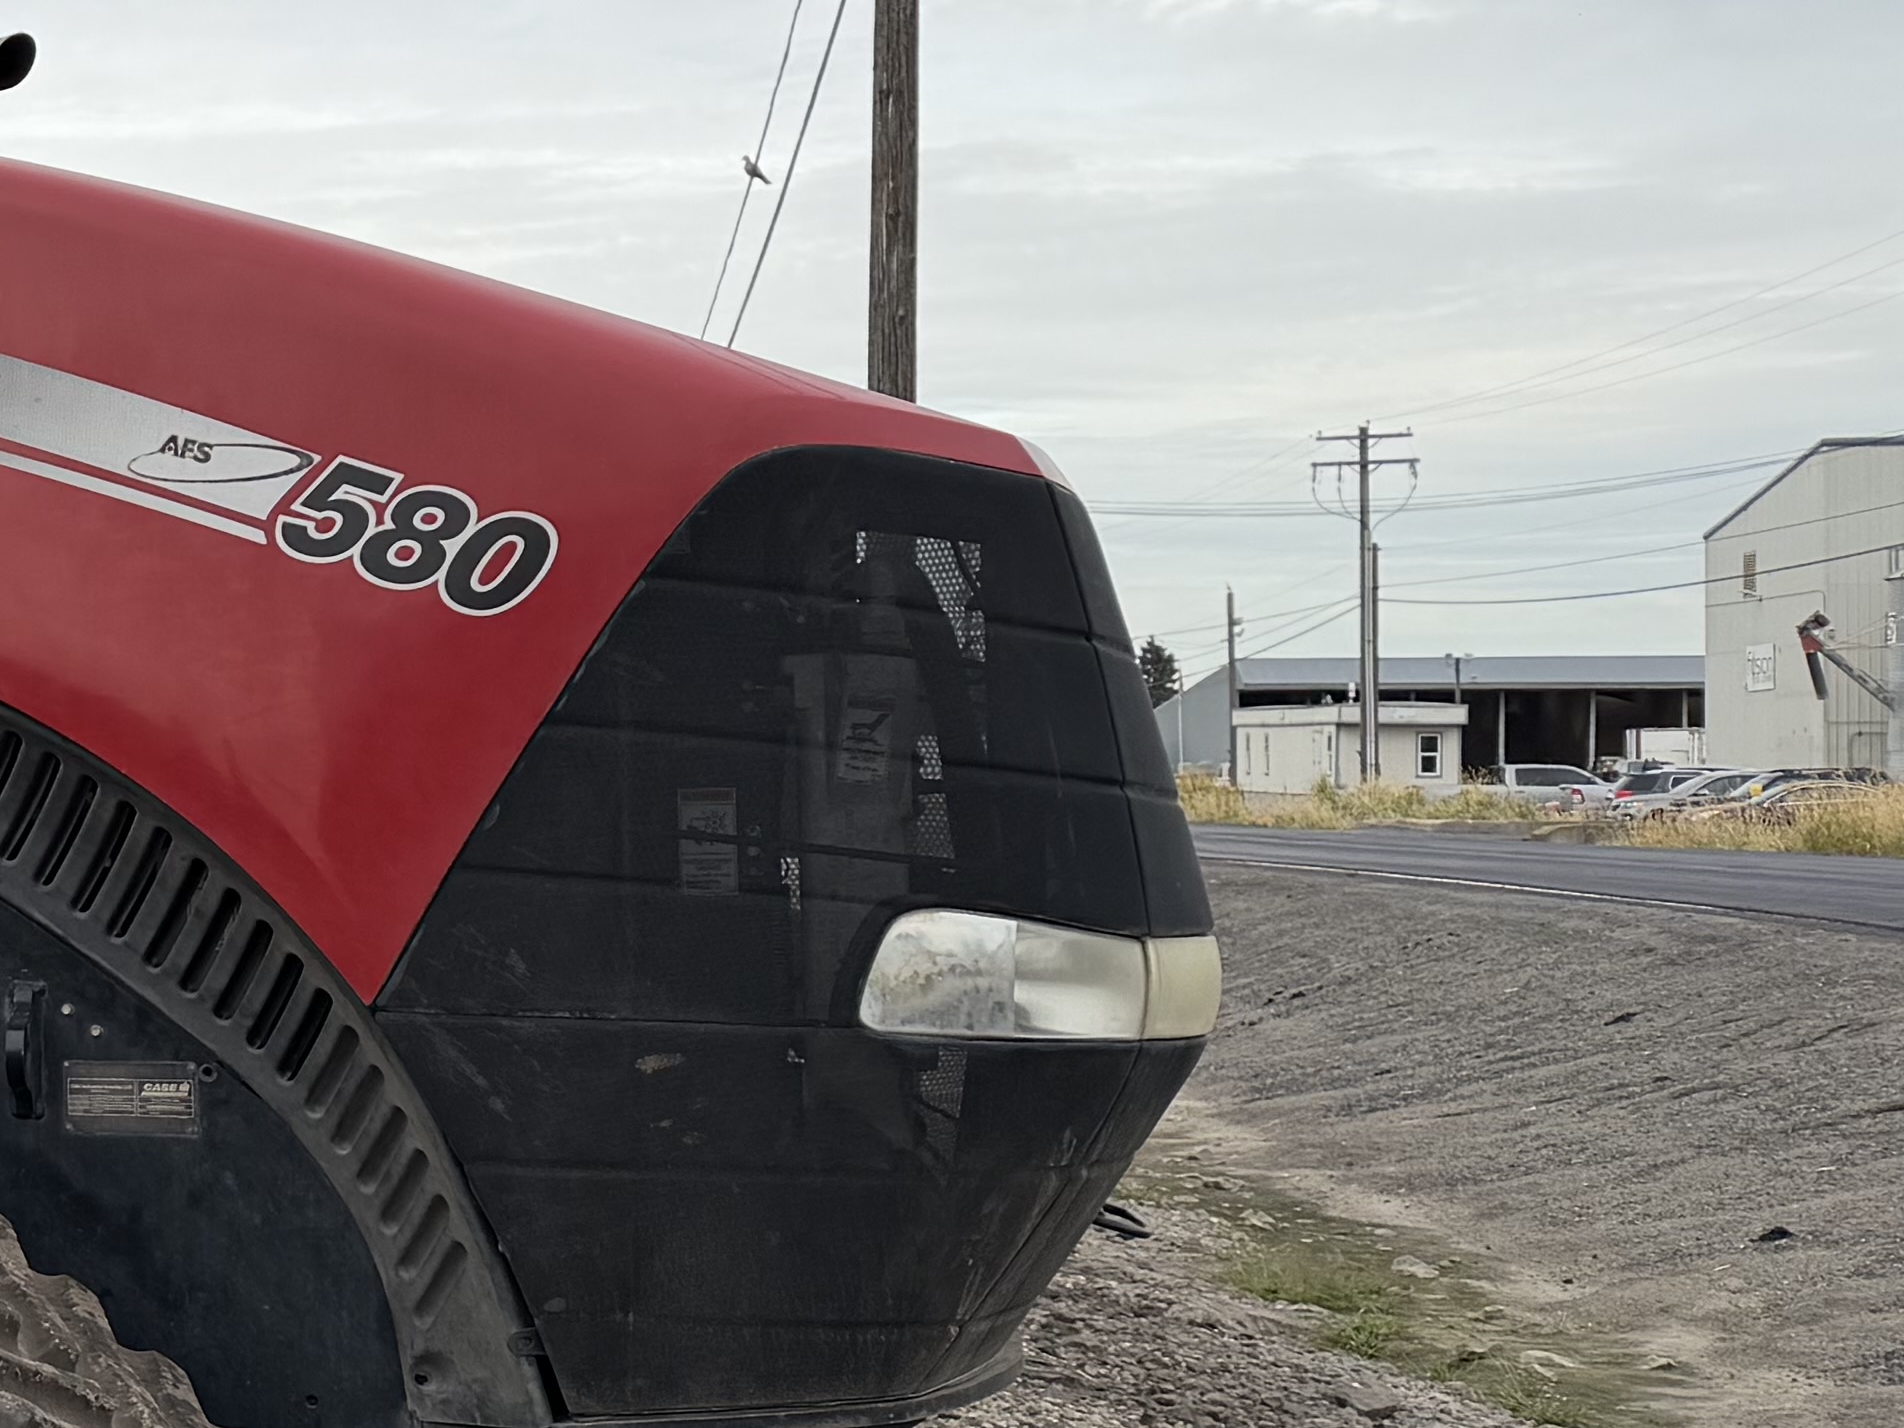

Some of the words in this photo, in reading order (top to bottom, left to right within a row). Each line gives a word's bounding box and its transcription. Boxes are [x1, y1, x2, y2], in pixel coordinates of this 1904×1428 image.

[159, 434, 214, 464] AFS
[274, 454, 560, 618] 580
[143, 1082, 177, 1093] CASE
